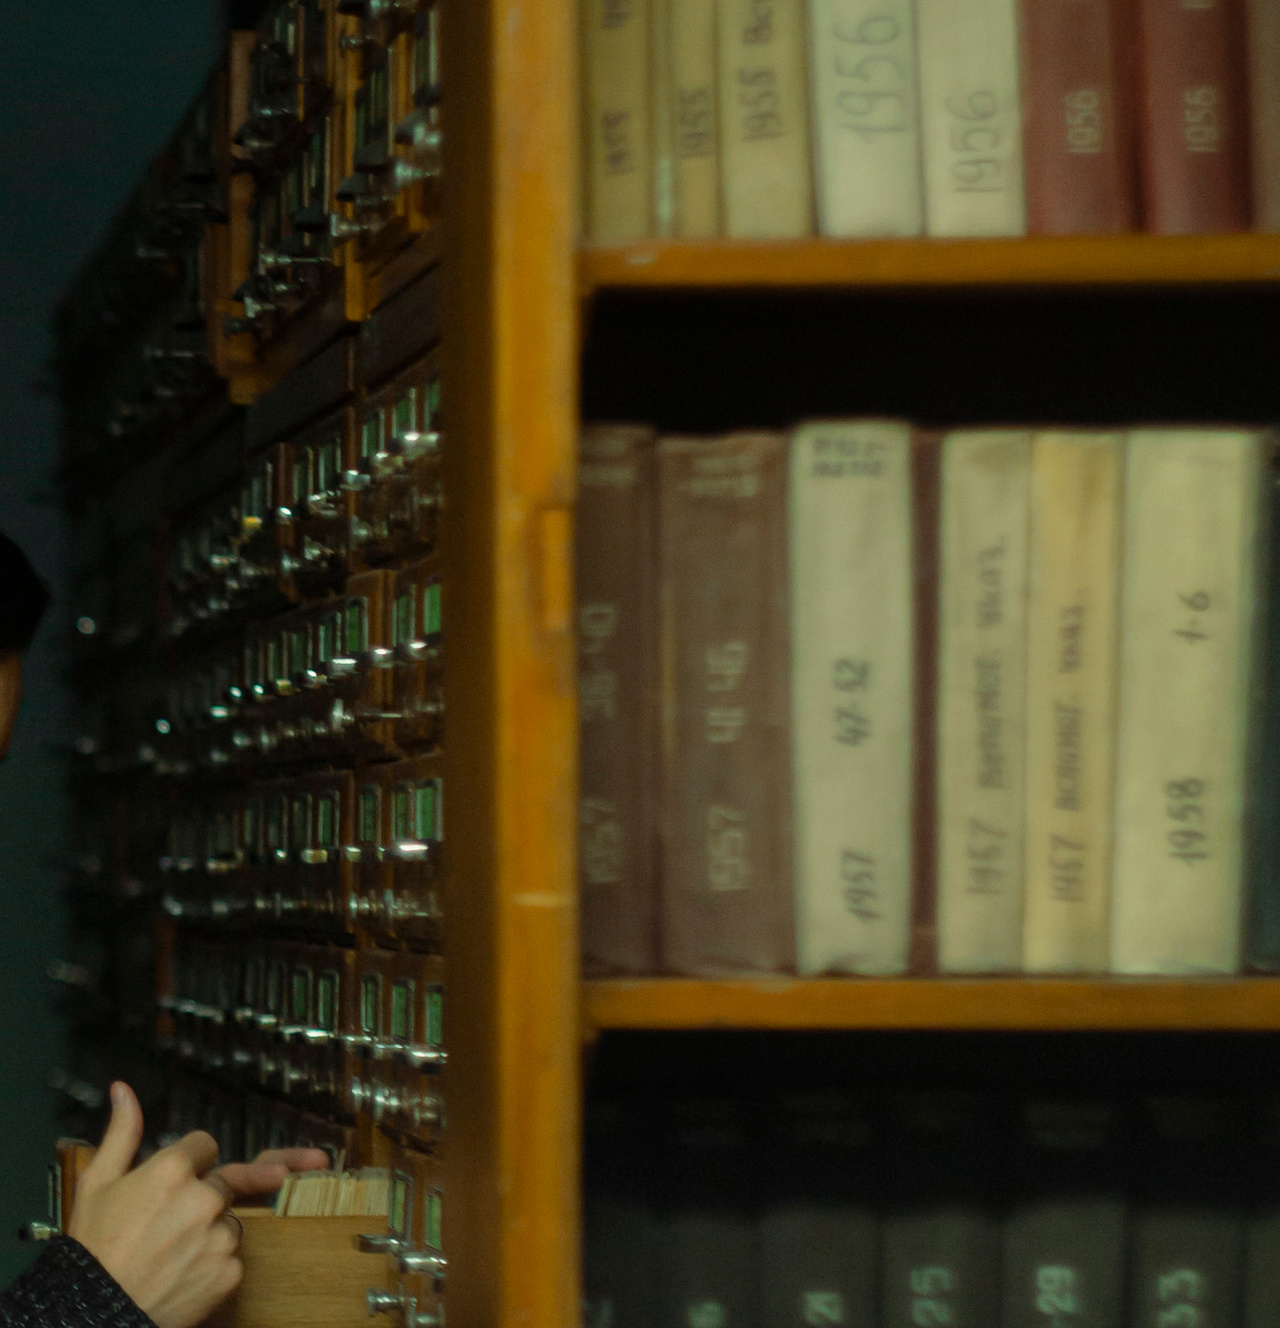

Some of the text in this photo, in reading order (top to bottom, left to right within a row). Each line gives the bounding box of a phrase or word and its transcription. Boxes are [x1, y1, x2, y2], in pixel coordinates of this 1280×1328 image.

[738, 69, 783, 140] 1955
[832, 14, 906, 142] 1956
[945, 89, 1002, 194] 1956
[1065, 90, 1102, 154] 1956
[1185, 87, 1218, 152] 1956
[707, 805, 748, 891] 1957
[1164, 777, 1207, 865] 1958
[842, 849, 879, 920] 1957
